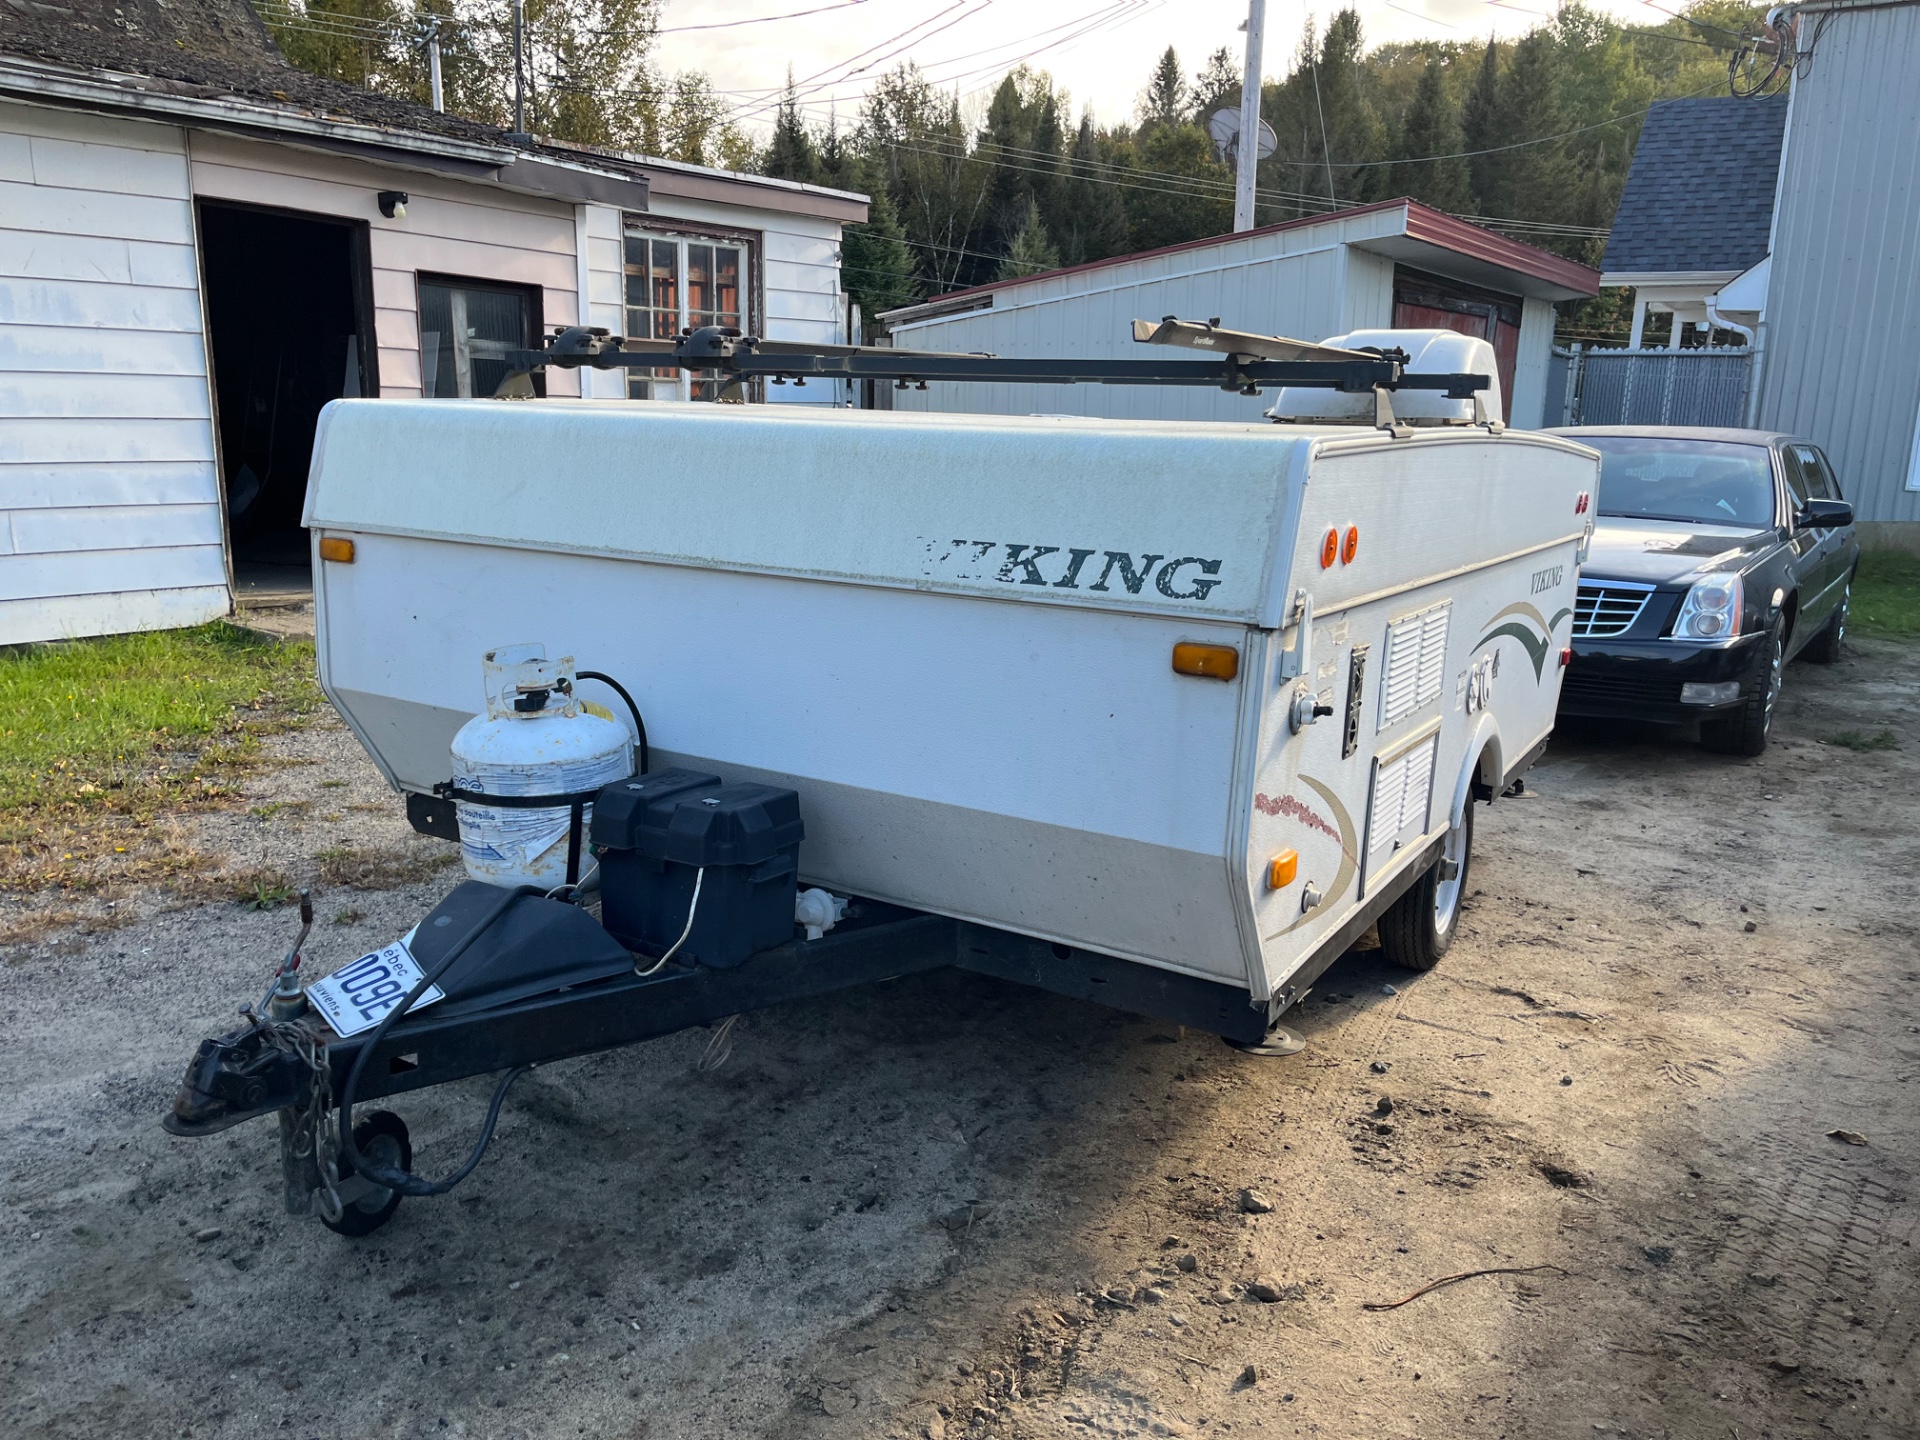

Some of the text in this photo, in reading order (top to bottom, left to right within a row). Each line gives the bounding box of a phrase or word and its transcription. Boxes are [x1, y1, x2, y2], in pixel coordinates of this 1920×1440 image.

[916, 536, 1223, 601] KING
[1530, 565, 1563, 595] VIKING
[383, 948, 408, 977] ébec
